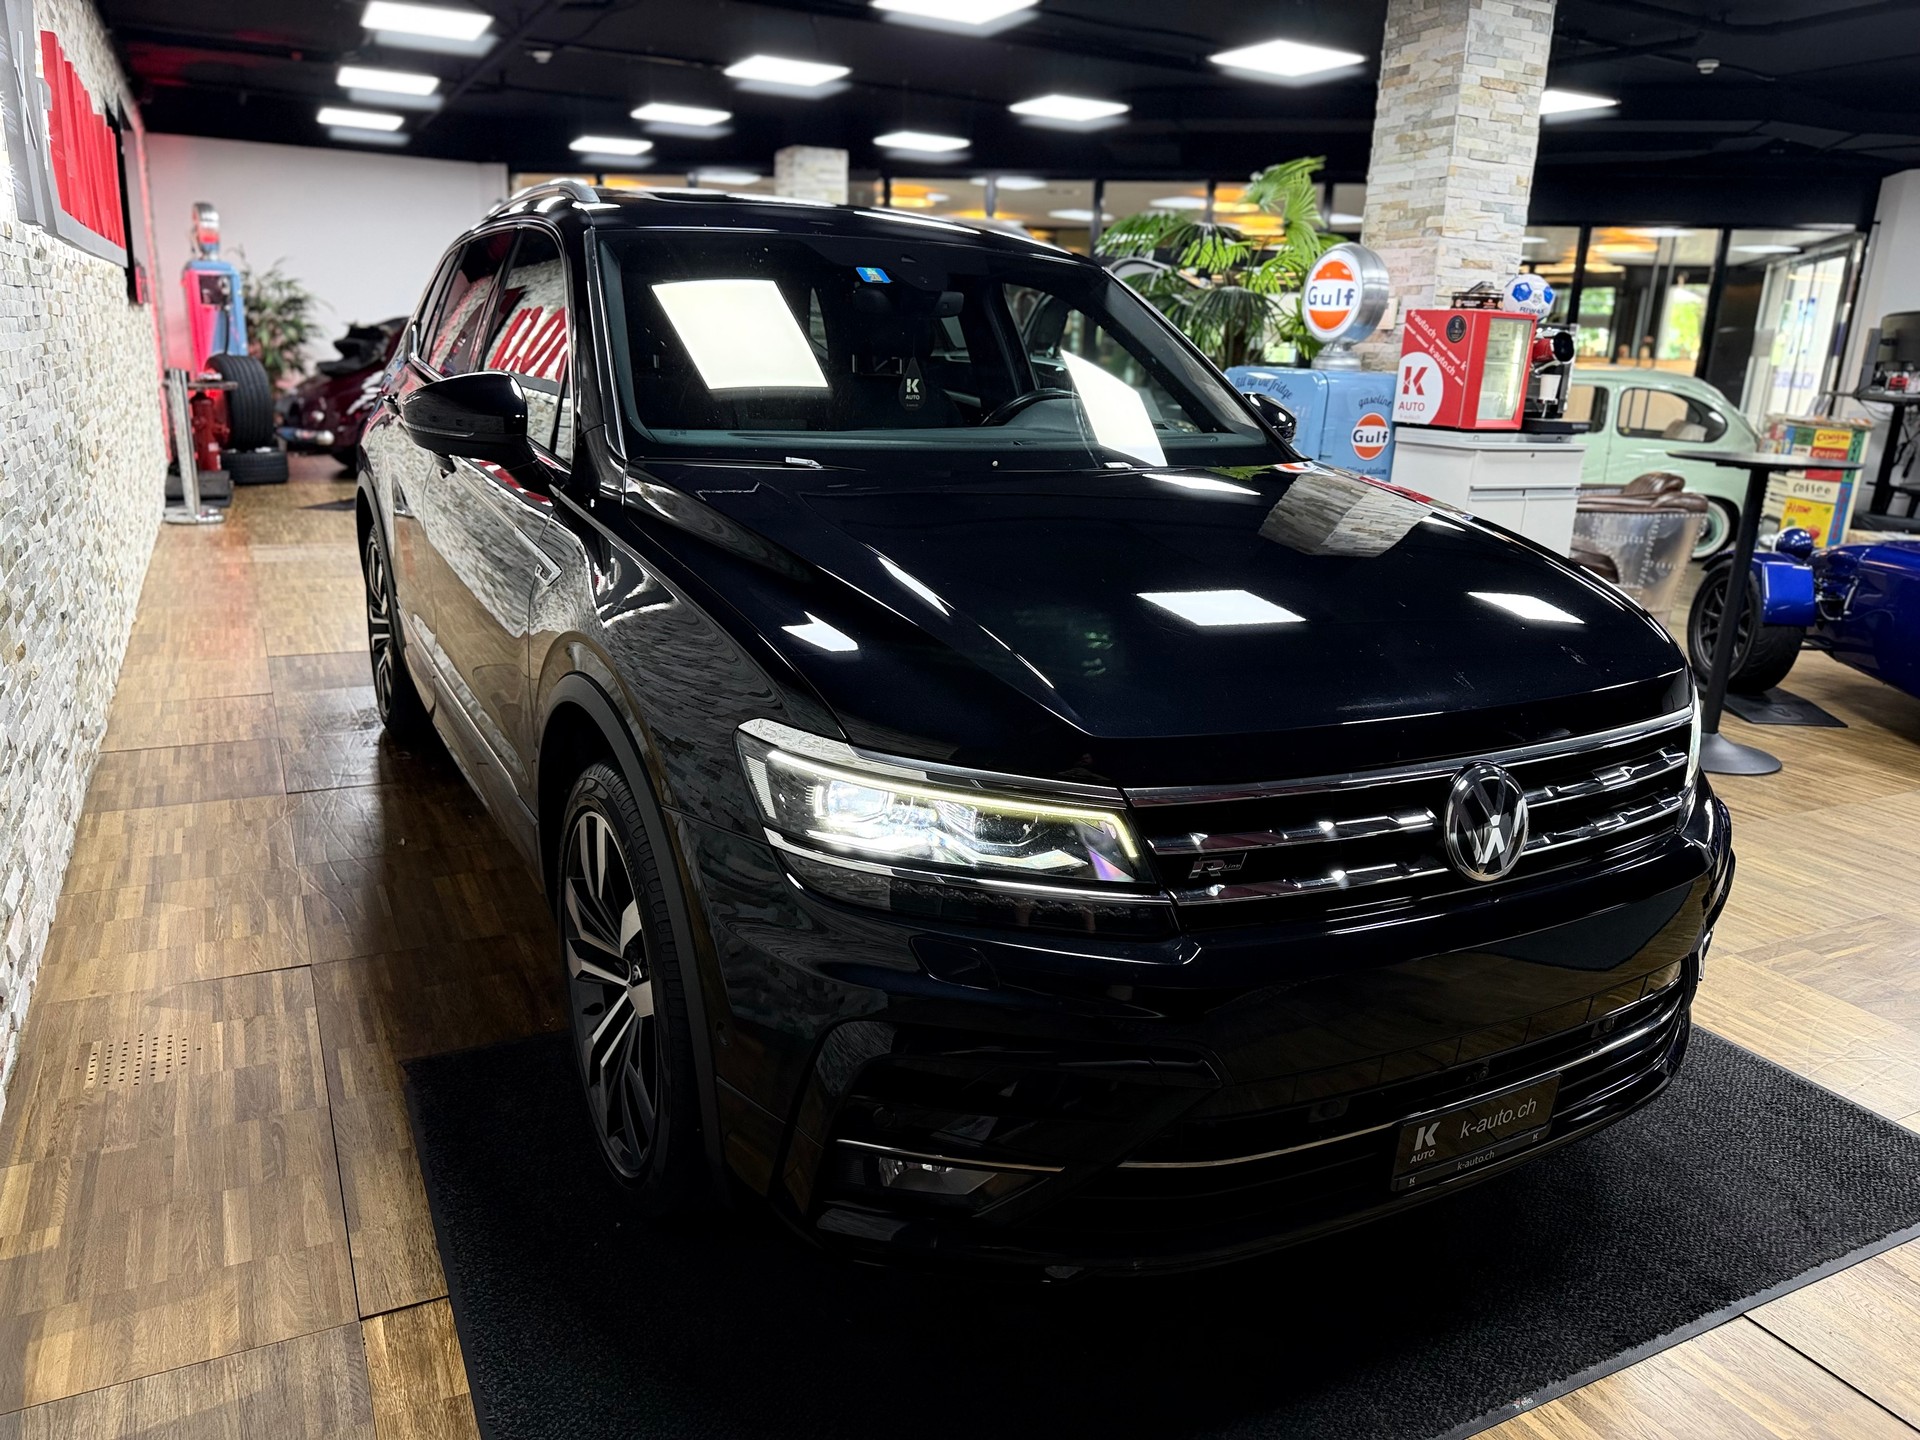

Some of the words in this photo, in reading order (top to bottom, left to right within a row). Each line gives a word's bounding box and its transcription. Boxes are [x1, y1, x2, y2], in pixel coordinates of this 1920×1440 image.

[1307, 286, 1355, 306] Gulf
[1410, 309, 1437, 339] k-auto.ch
[1428, 344, 1456, 376] k-auto.ch
[906, 378, 920, 393] K
[1267, 379, 1294, 400] fridge
[1402, 366, 1428, 396] K
[1358, 395, 1392, 409] gasoline
[1398, 401, 1426, 412] AUTO
[1353, 429, 1389, 444] Gulf
[1414, 1121, 1441, 1151] K
[1460, 1097, 1537, 1139] k-auto.ch
[1409, 1149, 1436, 1164] AUTO
[1457, 1150, 1495, 1170] k-auto.ch
